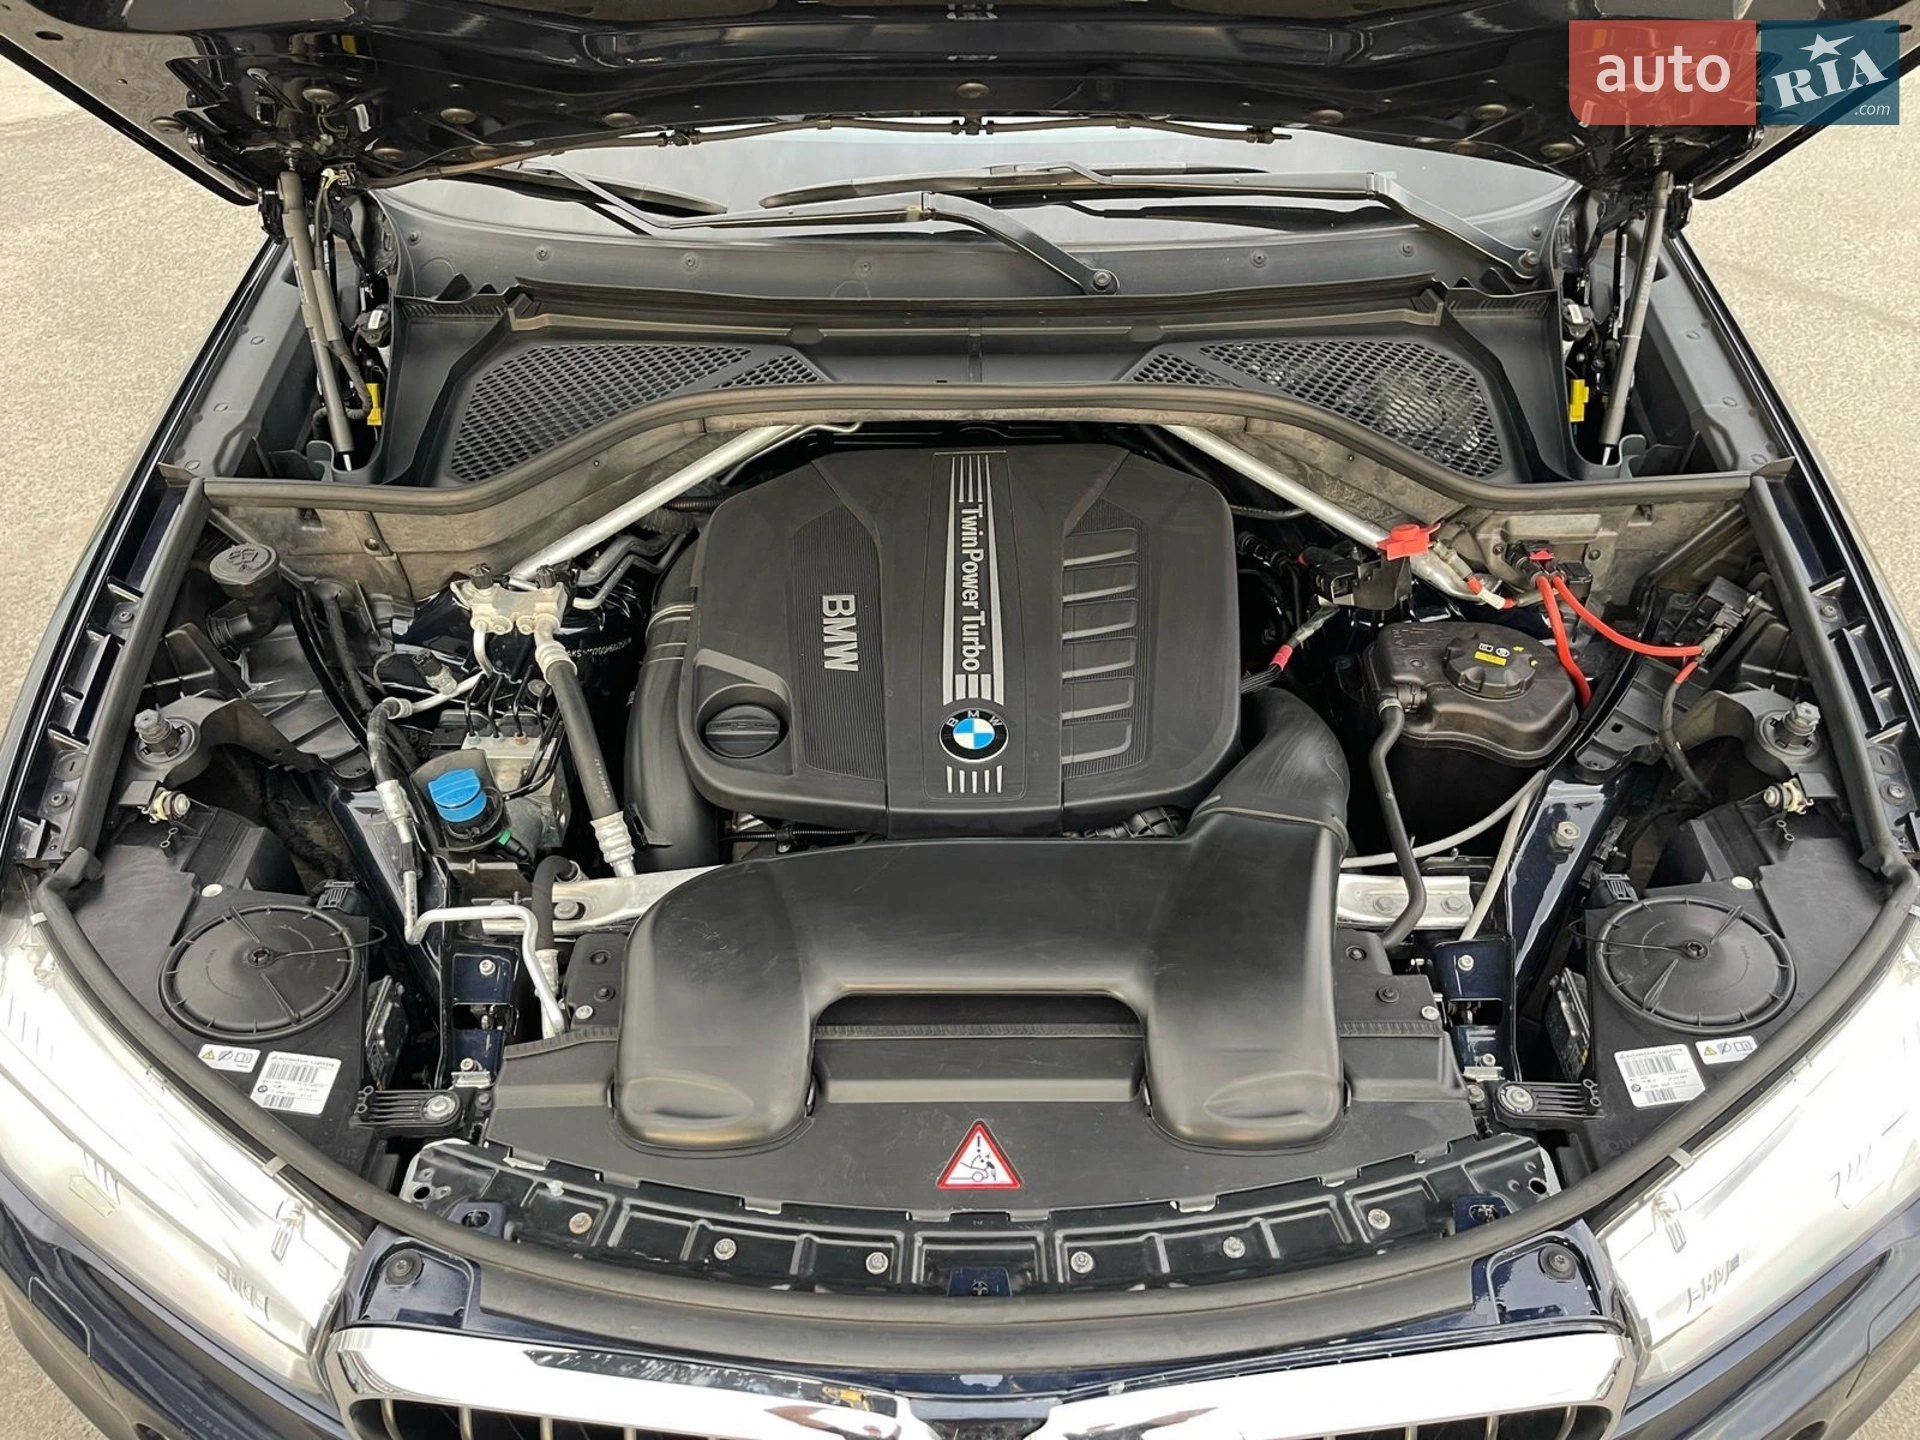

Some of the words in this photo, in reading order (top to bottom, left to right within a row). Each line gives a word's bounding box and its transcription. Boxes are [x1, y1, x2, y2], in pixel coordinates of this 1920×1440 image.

[961, 504, 984, 609] TwinPower
[823, 595, 858, 672] BMW
[962, 611, 986, 672] Turbo
[946, 710, 1003, 727] BMW
